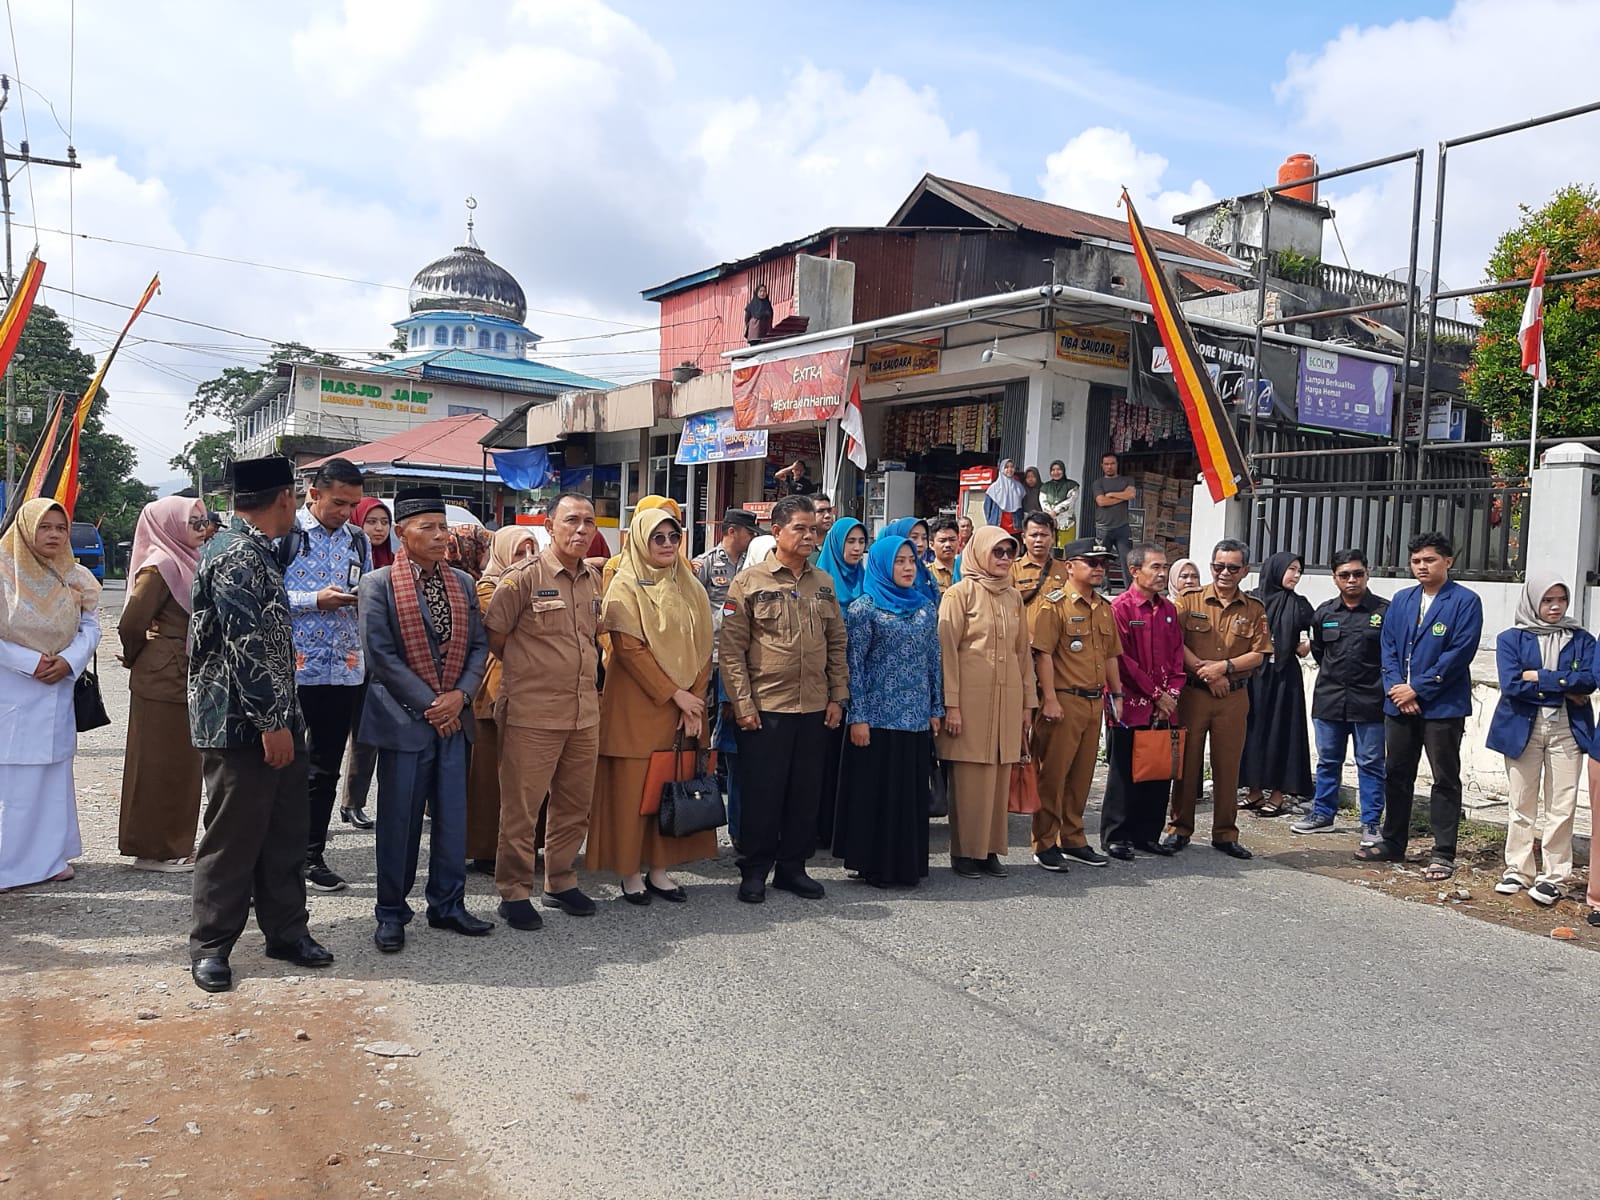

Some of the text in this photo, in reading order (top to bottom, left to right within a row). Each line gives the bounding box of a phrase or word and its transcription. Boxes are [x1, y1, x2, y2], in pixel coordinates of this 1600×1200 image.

[1080, 339, 1116, 355] SAUDARA
[882, 356, 912, 370] SAUDARA
[1233, 352, 1256, 370] TAST
[320, 379, 382, 398] MASJID
[1305, 374, 1356, 391] Lampu Berkualitas
